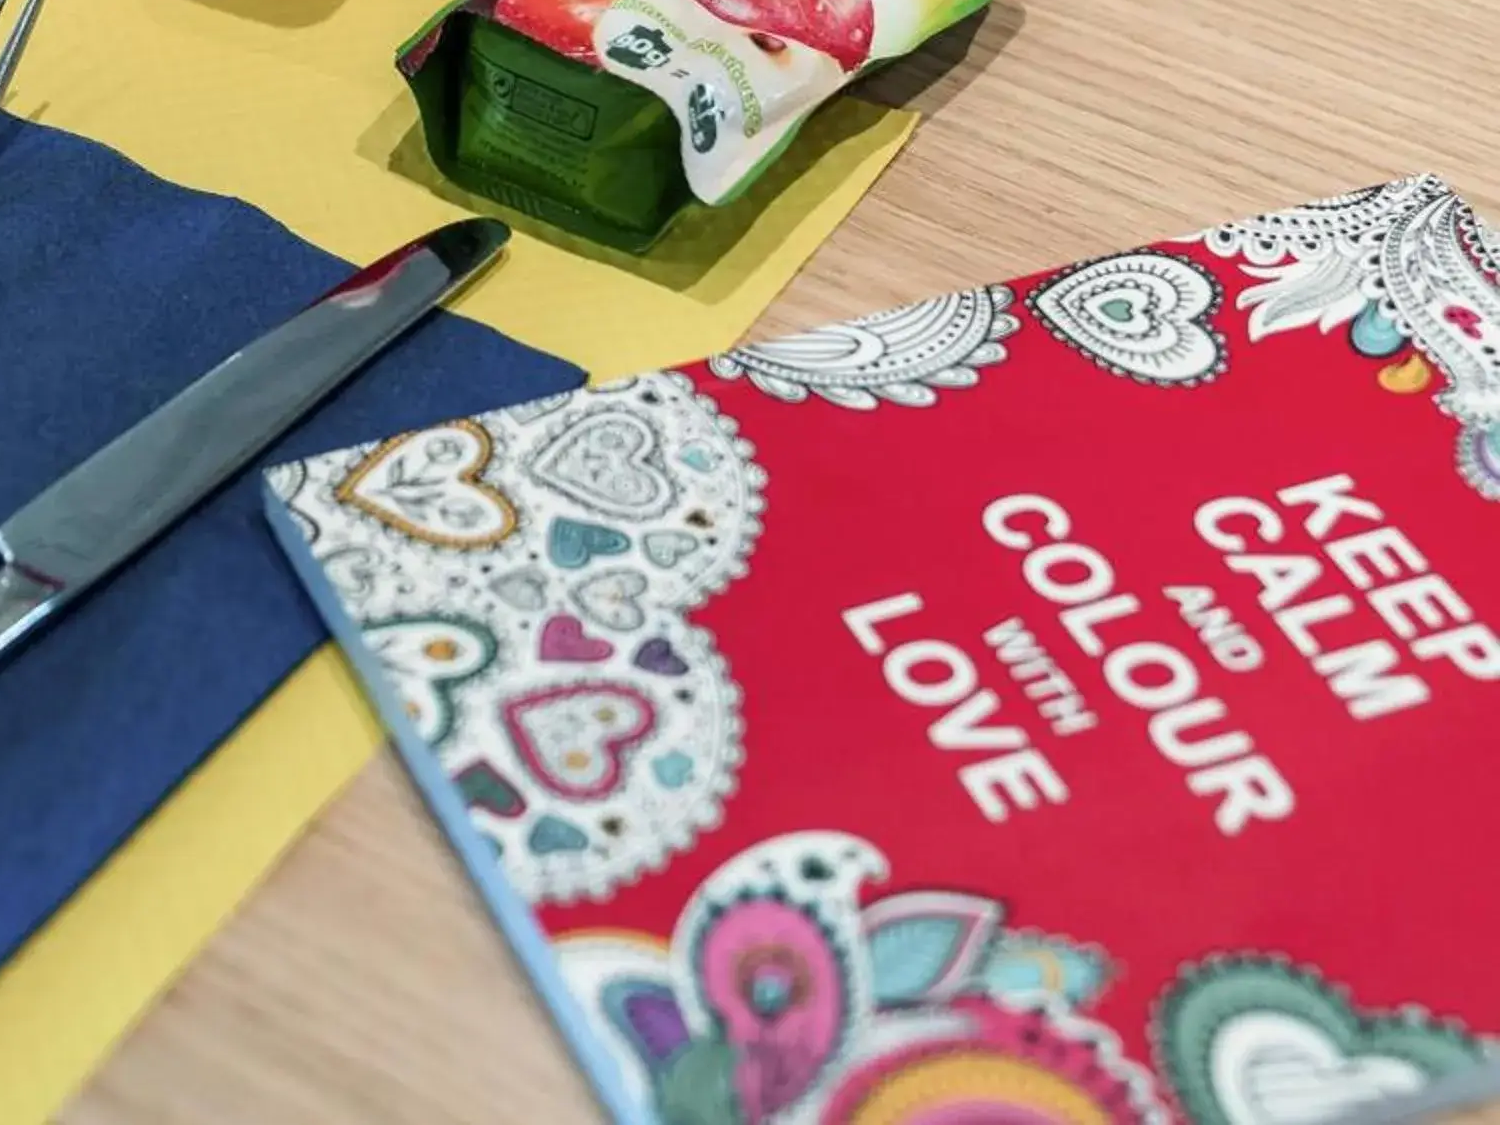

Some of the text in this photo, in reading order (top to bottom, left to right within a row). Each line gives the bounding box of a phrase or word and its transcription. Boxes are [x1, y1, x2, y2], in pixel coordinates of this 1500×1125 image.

[611, 33, 670, 68] 90g
[980, 492, 1296, 837] COLOUR
[981, 616, 1099, 737] WITH
[1161, 584, 1265, 673] AND
[1192, 495, 1431, 721] CALM
[1276, 473, 1500, 682] KEEP
[841, 592, 1071, 825] LOVE
